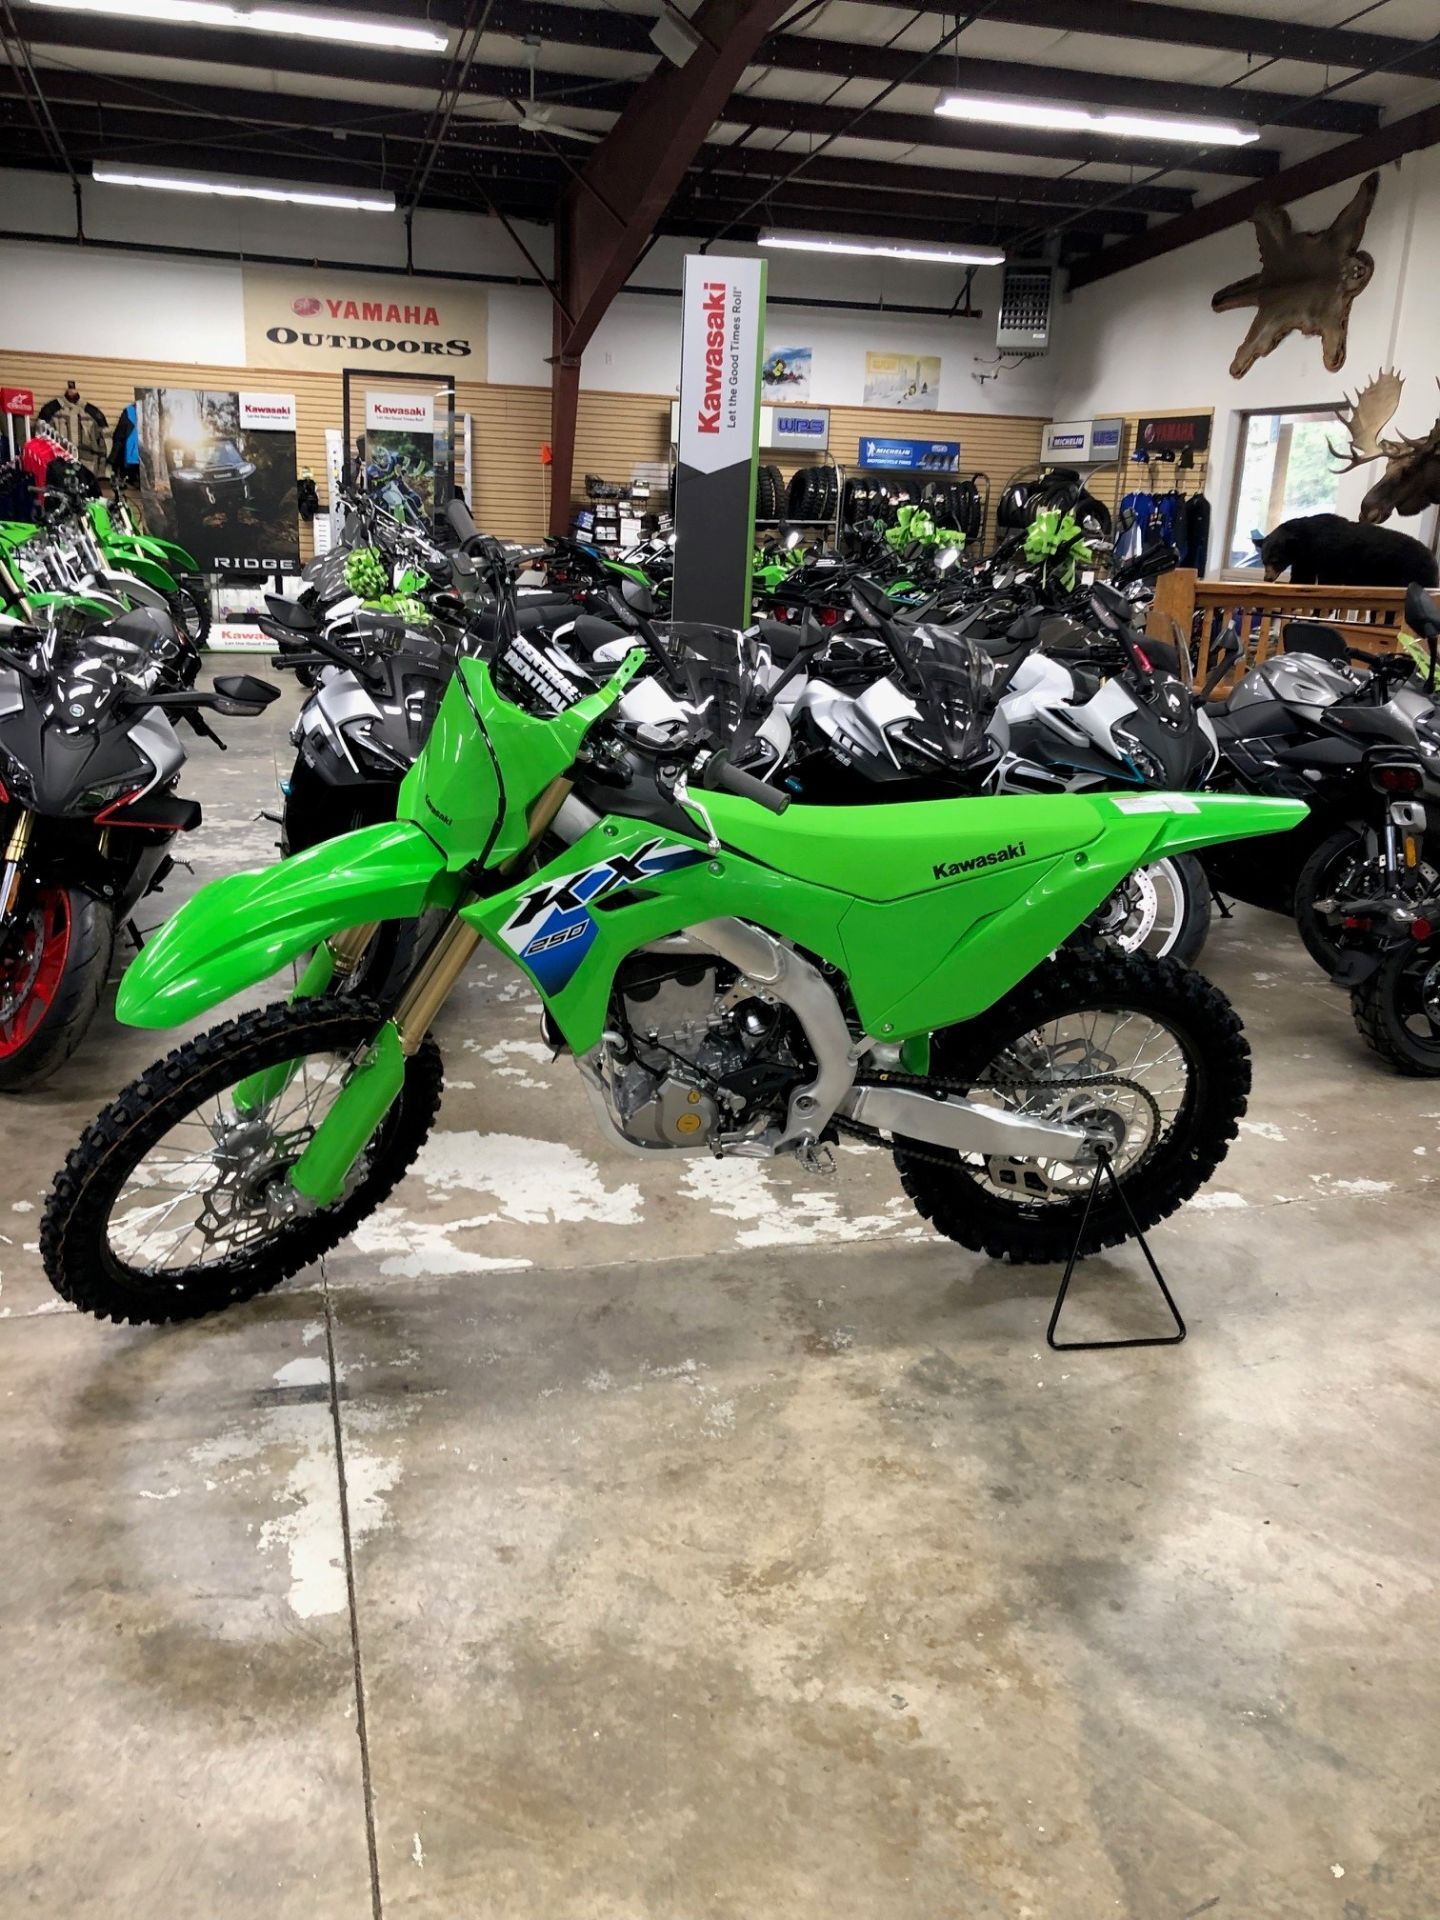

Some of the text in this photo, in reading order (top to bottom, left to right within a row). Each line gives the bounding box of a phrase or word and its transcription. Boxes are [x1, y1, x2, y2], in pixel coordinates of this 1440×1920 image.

[326, 299, 440, 326] YAMAHA
[266, 327, 472, 357] OUTDOORS
[730, 317, 741, 351] Times
[698, 283, 726, 433] Kawasaki
[729, 355, 739, 385] Good
[728, 388, 738, 406] the
[245, 405, 291, 415] Kawasaki
[374, 404, 426, 416] Kawasaki
[727, 410, 736, 428] Let
[778, 417, 825, 434] WPS
[1053, 436, 1084, 447] MICHELIN
[876, 448, 911, 456] MICHELIN
[214, 557, 294, 570] RIDGE
[221, 631, 273, 641] Kawas
[932, 841, 1026, 880] Kawasaki
[506, 837, 666, 931] KX
[524, 919, 590, 957] 250
